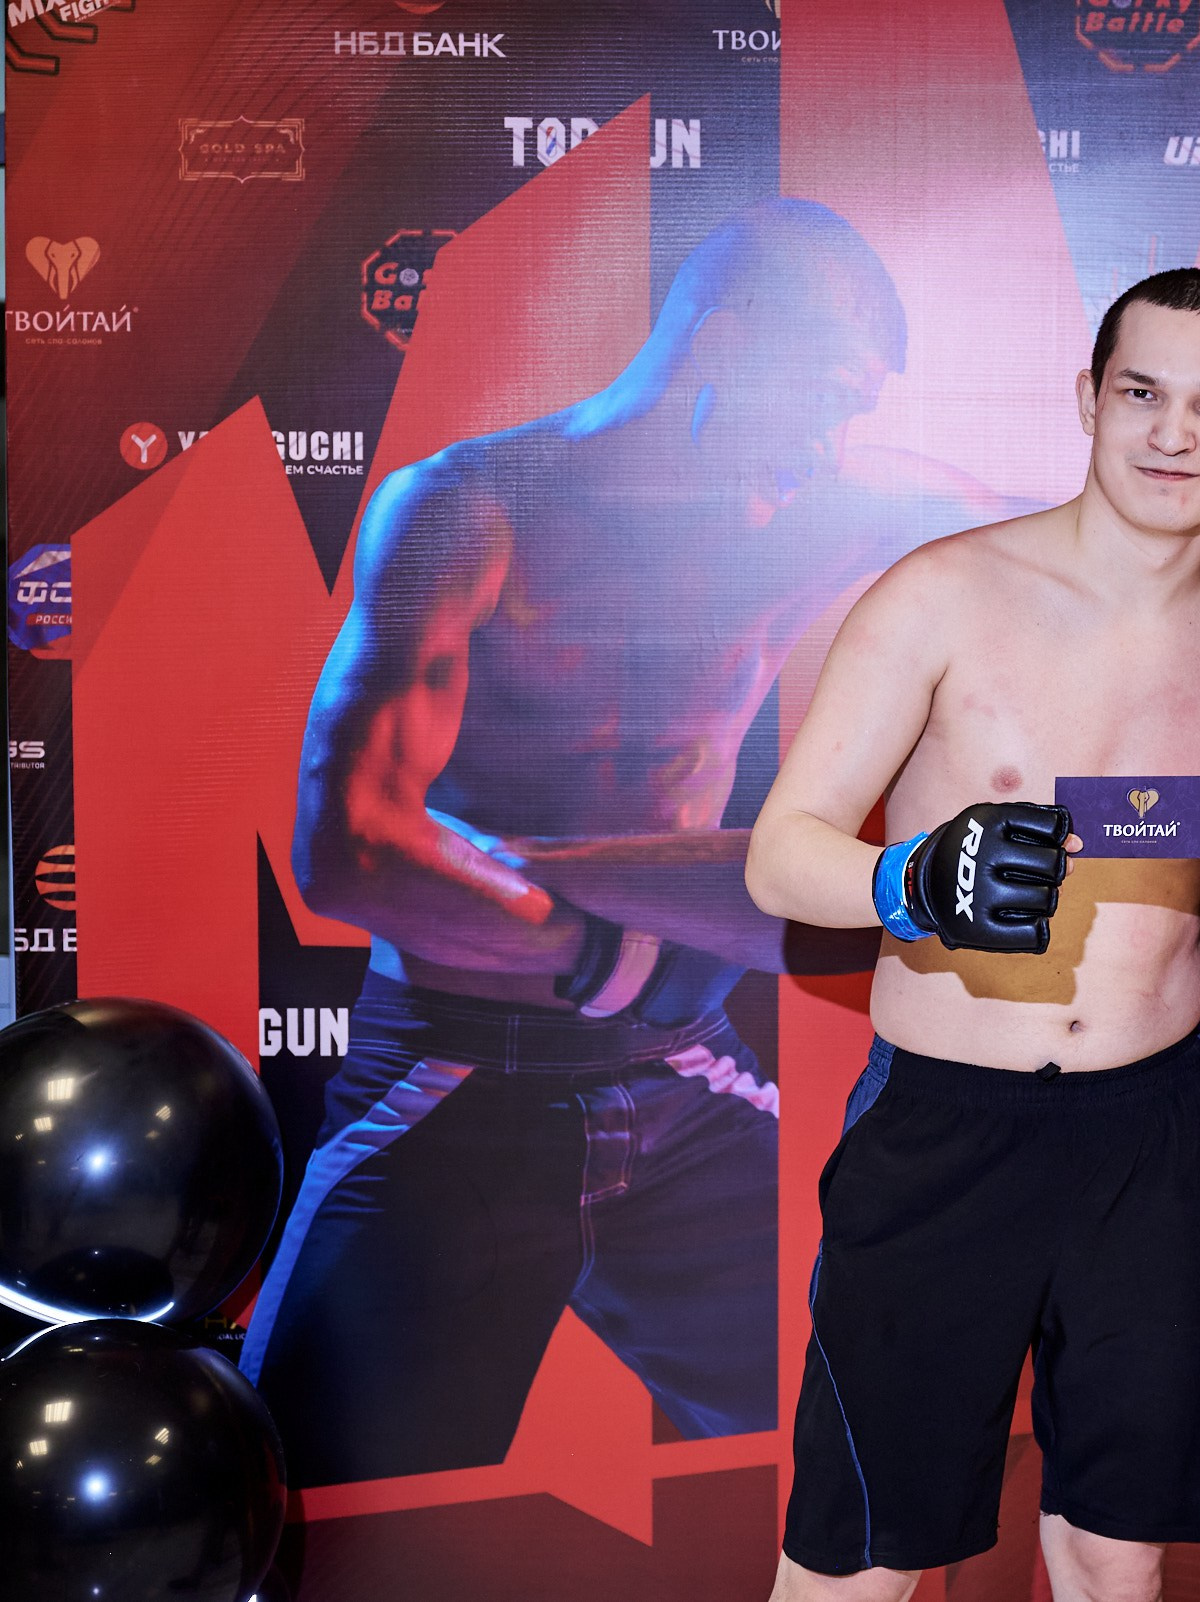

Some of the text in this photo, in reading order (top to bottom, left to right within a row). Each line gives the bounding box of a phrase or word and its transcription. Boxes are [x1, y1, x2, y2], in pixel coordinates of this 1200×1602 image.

[1085, 11, 1184, 33] Battle
[334, 31, 506, 57] НБД БАНК
[254, 143, 286, 154] SPA
[306, 465, 364, 475] СЧАСТЬЕ
[1102, 820, 1178, 838] ТВОЙТАЙ
[955, 817, 985, 923] RDX
